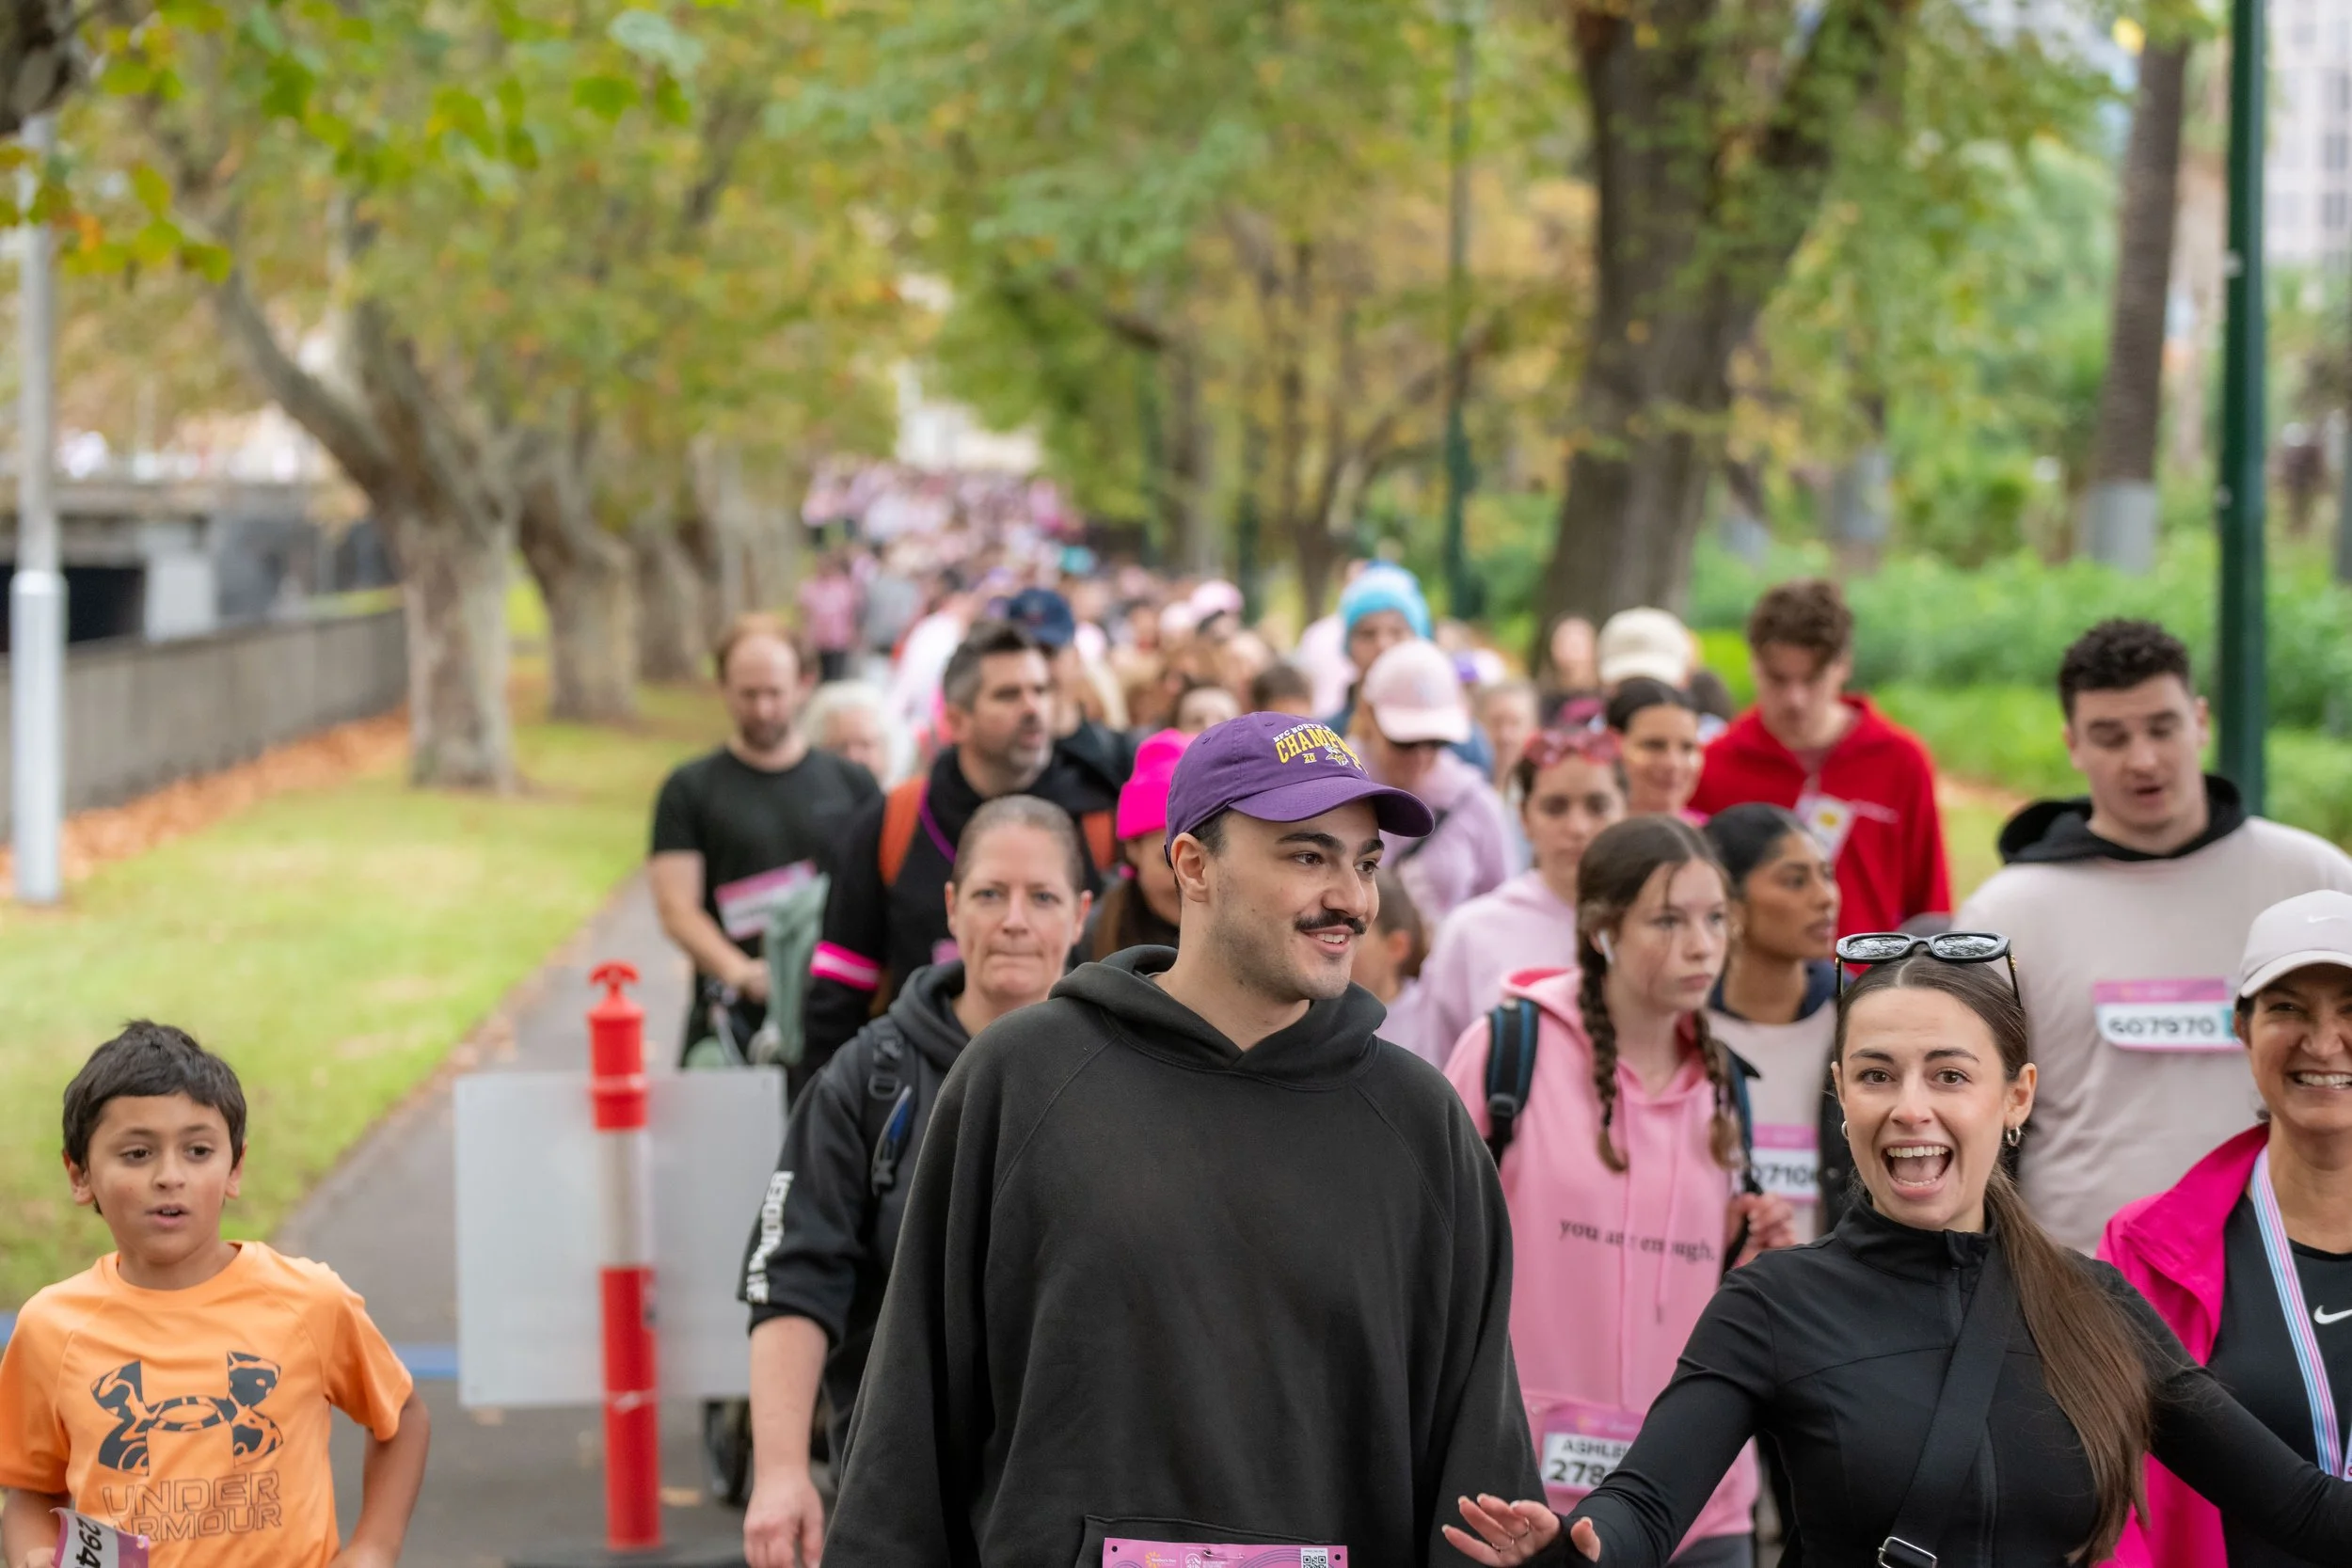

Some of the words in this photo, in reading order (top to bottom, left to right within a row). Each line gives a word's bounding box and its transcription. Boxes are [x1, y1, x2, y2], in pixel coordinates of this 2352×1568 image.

[1276, 728, 1368, 774] CHAMP
[1303, 753, 1316, 763] 20
[1559, 1220, 1598, 1241] you
[1641, 1236, 1714, 1265] enugh.
[103, 1471, 280, 1516] UNDER
[1549, 1459, 1614, 1485] 278
[75, 1516, 103, 1568] 294
